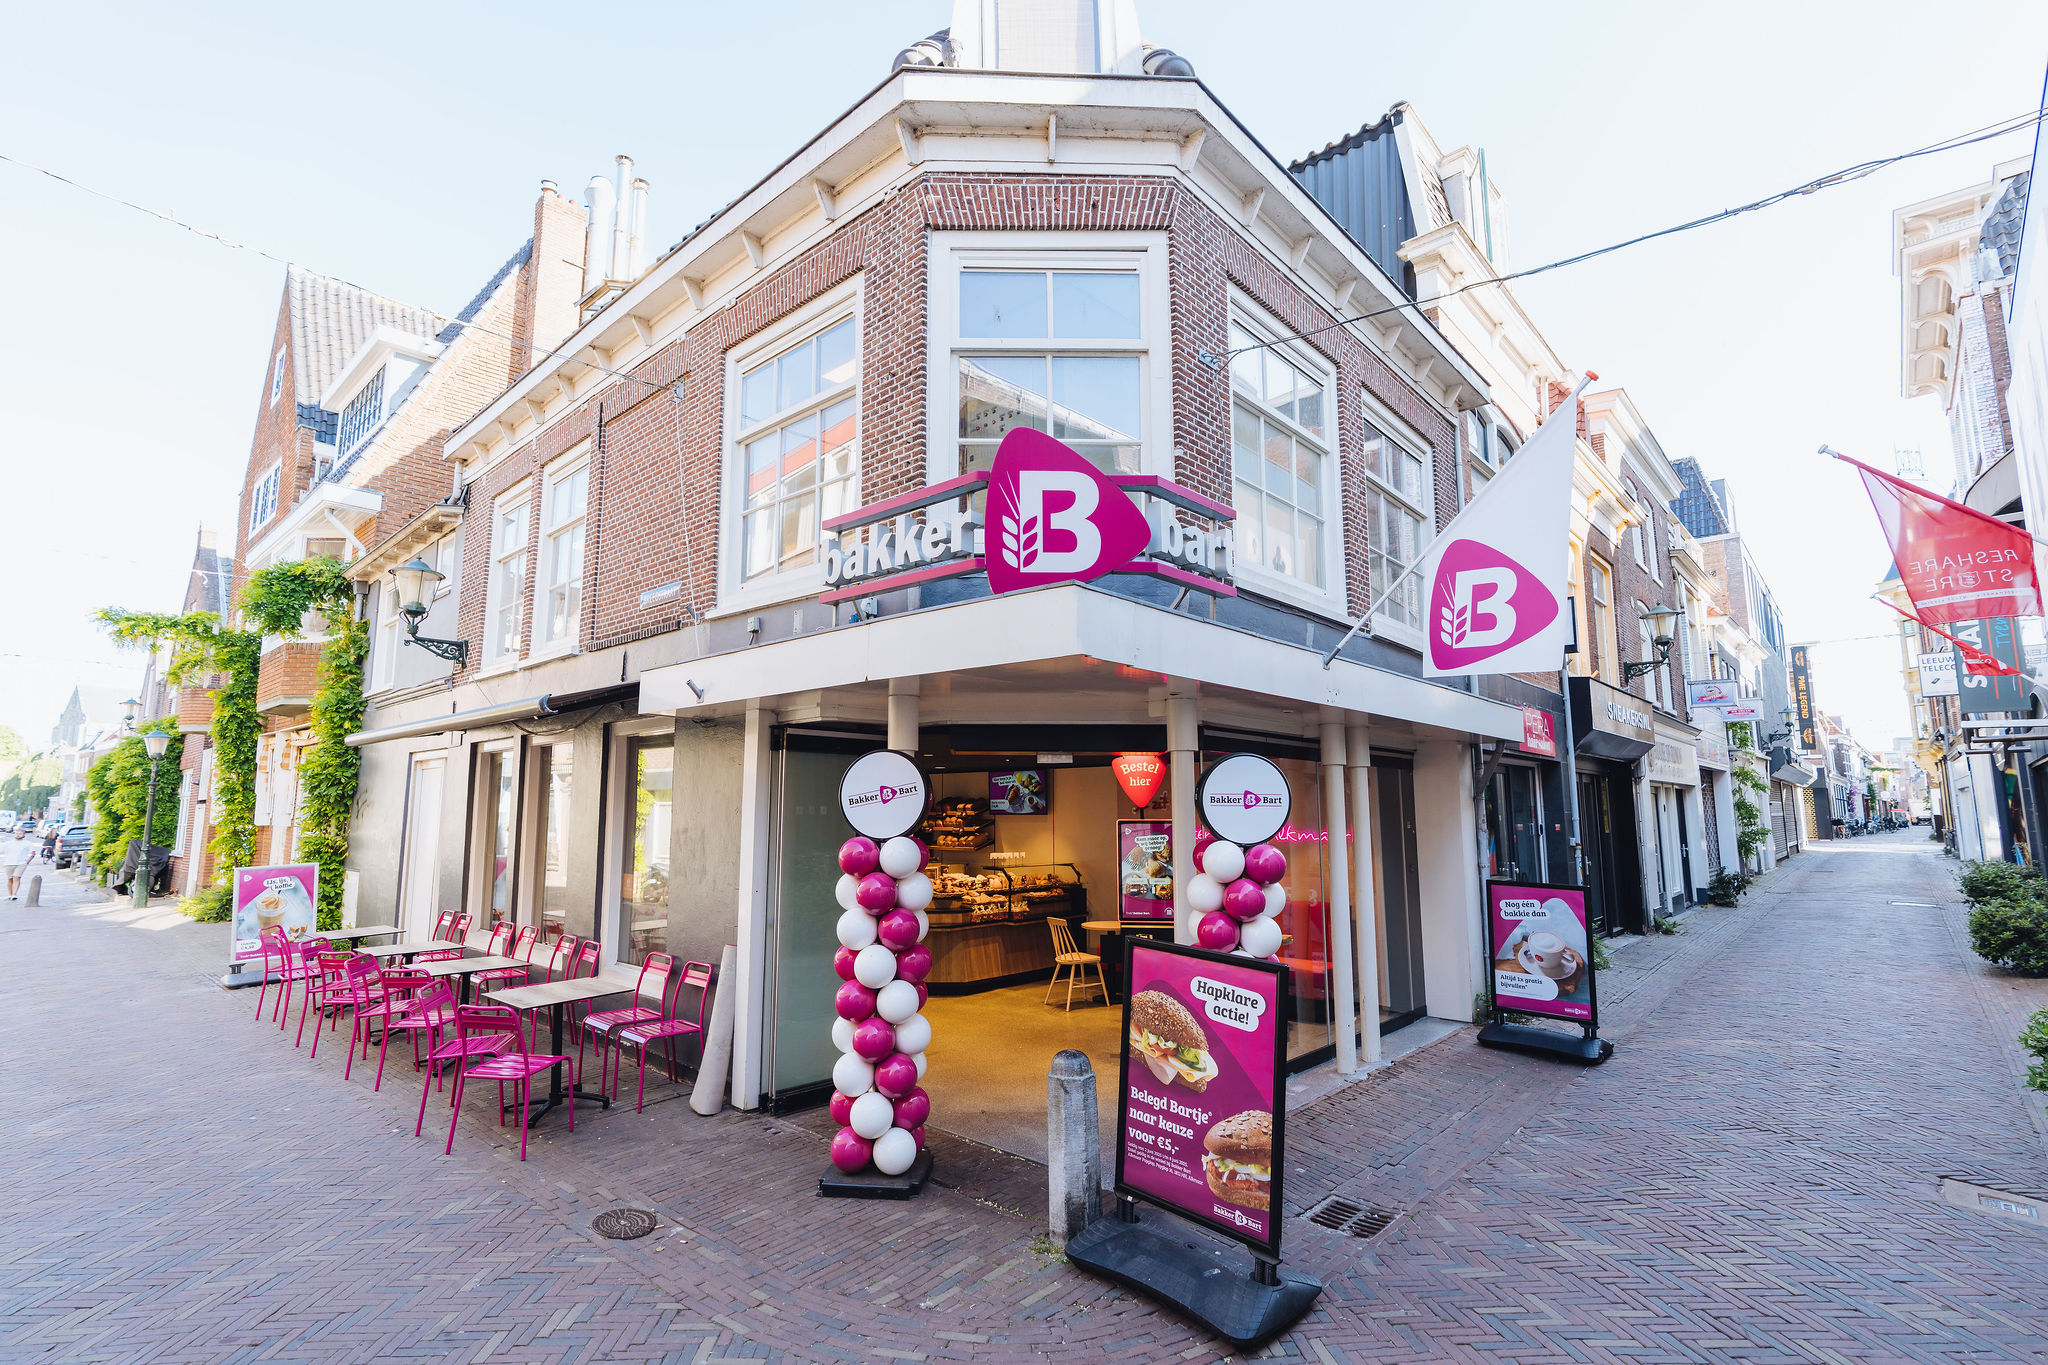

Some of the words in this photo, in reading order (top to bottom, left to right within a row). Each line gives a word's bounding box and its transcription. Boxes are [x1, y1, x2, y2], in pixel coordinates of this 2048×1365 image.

[822, 509, 978, 584] bakker
[1159, 498, 1237, 578] bart
[1798, 675, 1806, 690] PME
[1800, 692, 1809, 719] LEGEND
[1120, 762, 1159, 774] Bestel
[1129, 776, 1151, 786] hier
[848, 793, 879, 806] Bakker
[898, 785, 918, 795] Bart
[1210, 796, 1242, 804] Bakker
[1262, 796, 1282, 804] Bart
[1196, 980, 1258, 1009] Hapklare
[1213, 1005, 1249, 1025] actie!
[1131, 1086, 1168, 1110] Belegd
[1129, 1107, 1157, 1126] naar
[1158, 1115, 1194, 1139] keuze
[1128, 1127, 1155, 1145] voor
[1157, 1136, 1179, 1155] €5,-
[1214, 1206, 1234, 1219] Bakker
[1248, 1219, 1262, 1230] Bart
